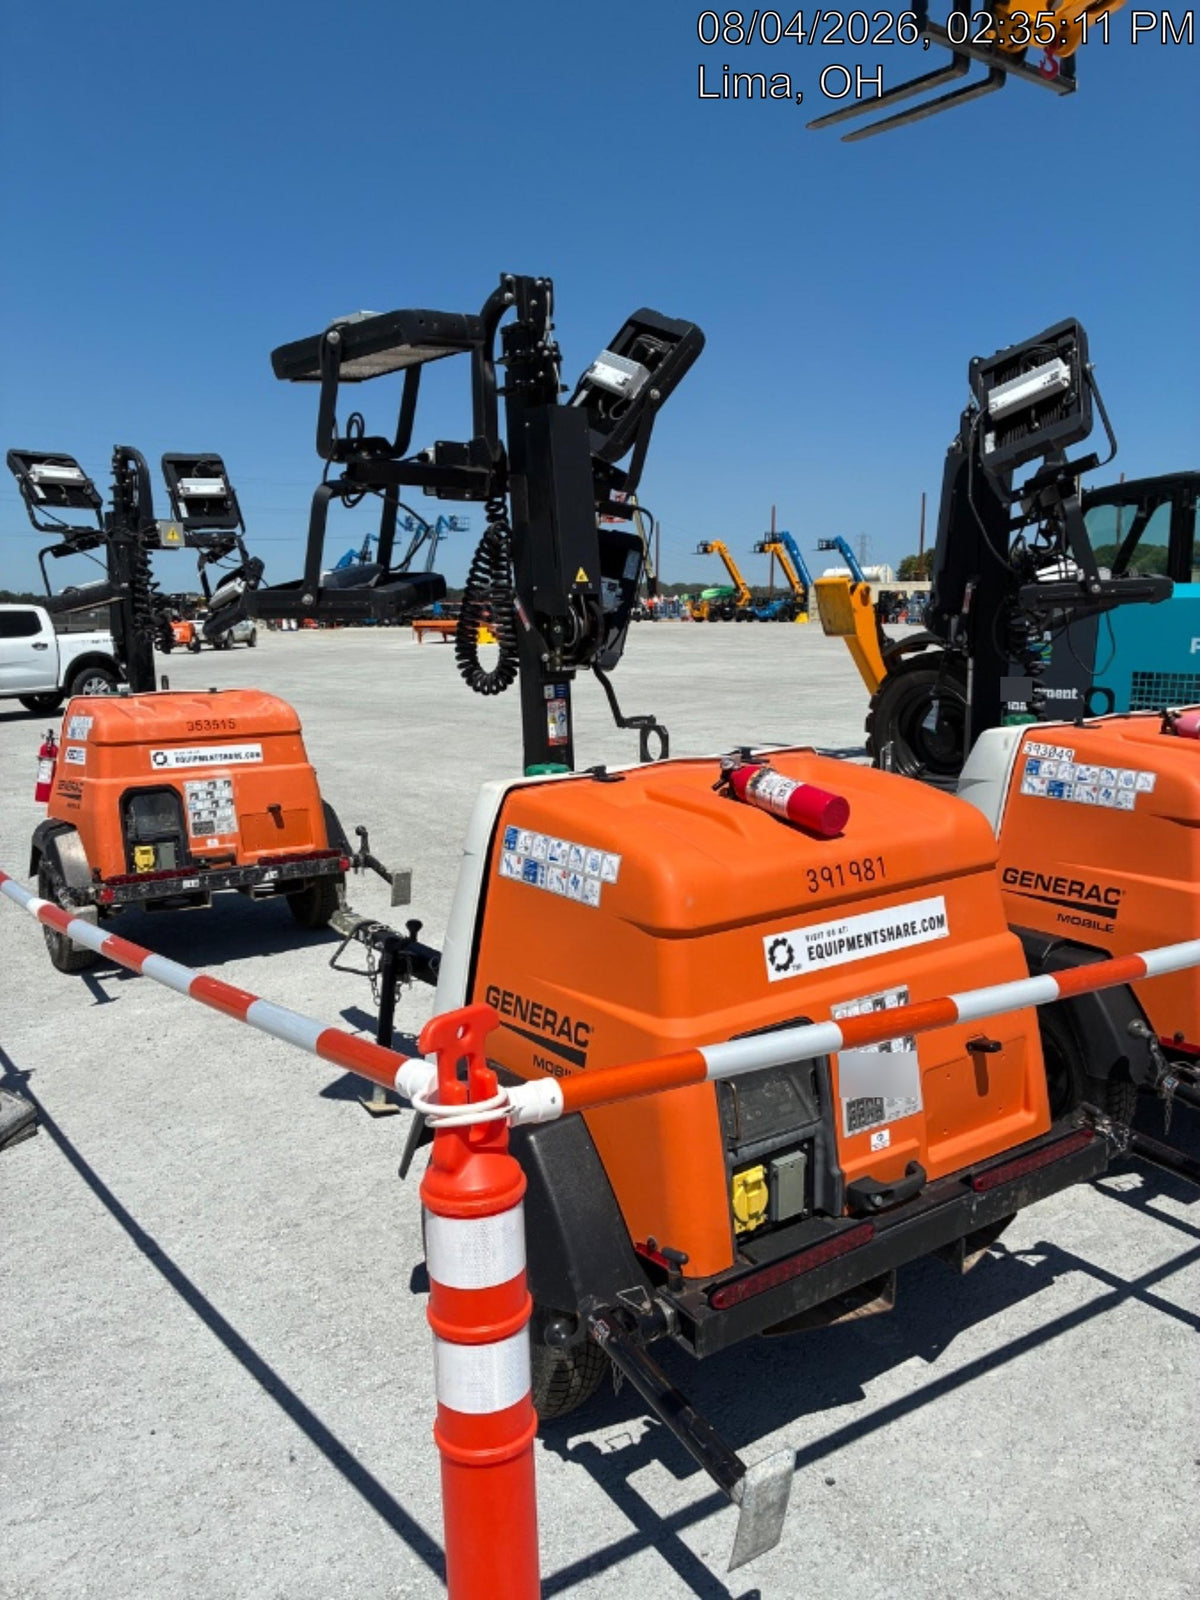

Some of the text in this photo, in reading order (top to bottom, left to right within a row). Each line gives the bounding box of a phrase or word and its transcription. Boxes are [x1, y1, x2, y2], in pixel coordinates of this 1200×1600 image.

[806, 856, 886, 894] 391981
[1002, 867, 1121, 906] GENERAC
[807, 914, 945, 962] EQUIPMENTSHARE.COM
[1057, 913, 1115, 934] MOBILE
[485, 984, 590, 1048] GENERAC
[533, 1054, 572, 1079] MOBI
